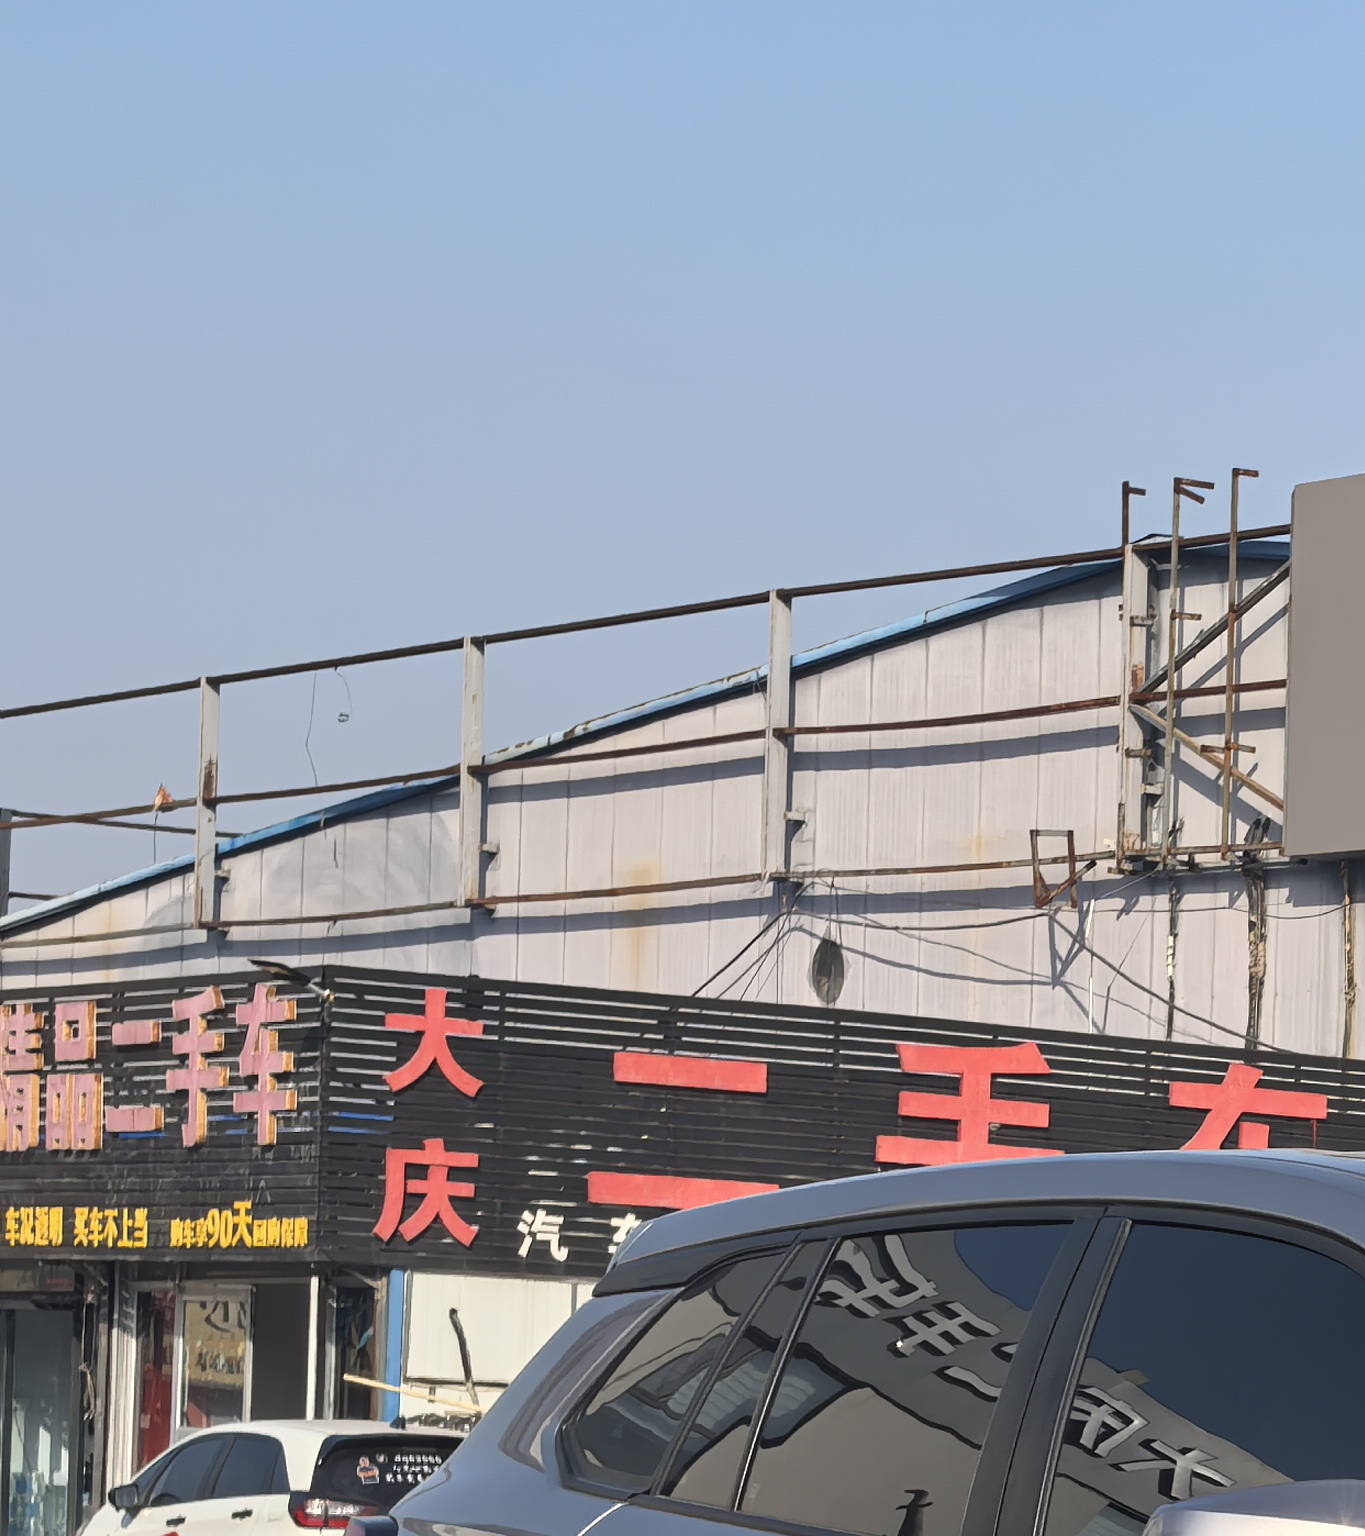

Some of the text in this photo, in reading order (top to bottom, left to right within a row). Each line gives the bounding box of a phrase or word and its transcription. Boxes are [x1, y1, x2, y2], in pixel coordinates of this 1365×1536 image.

[73, 1206, 148, 1248] 买车不上当
